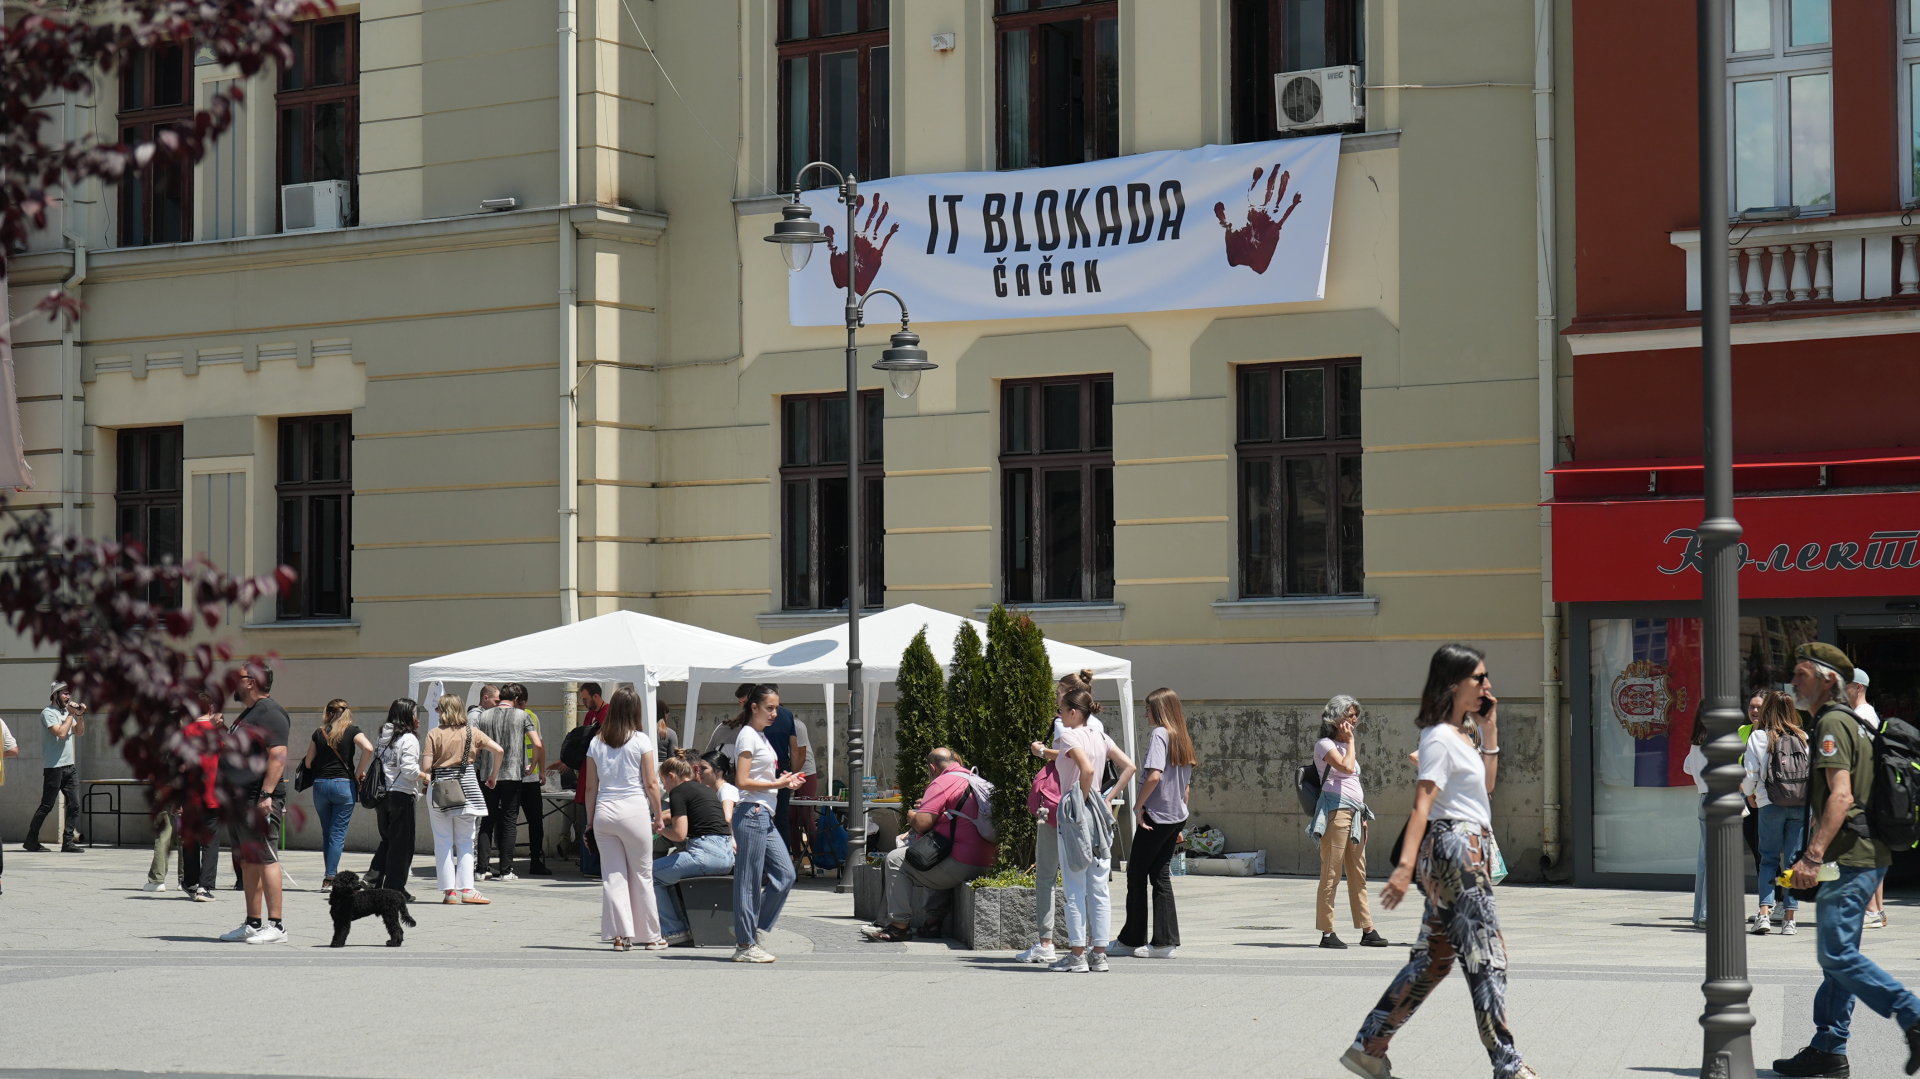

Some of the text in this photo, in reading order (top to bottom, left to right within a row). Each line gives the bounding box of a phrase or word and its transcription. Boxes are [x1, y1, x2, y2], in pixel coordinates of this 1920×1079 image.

[927, 179, 1186, 255] IT BLOKADA
[992, 255, 1102, 298] ČAČAK
